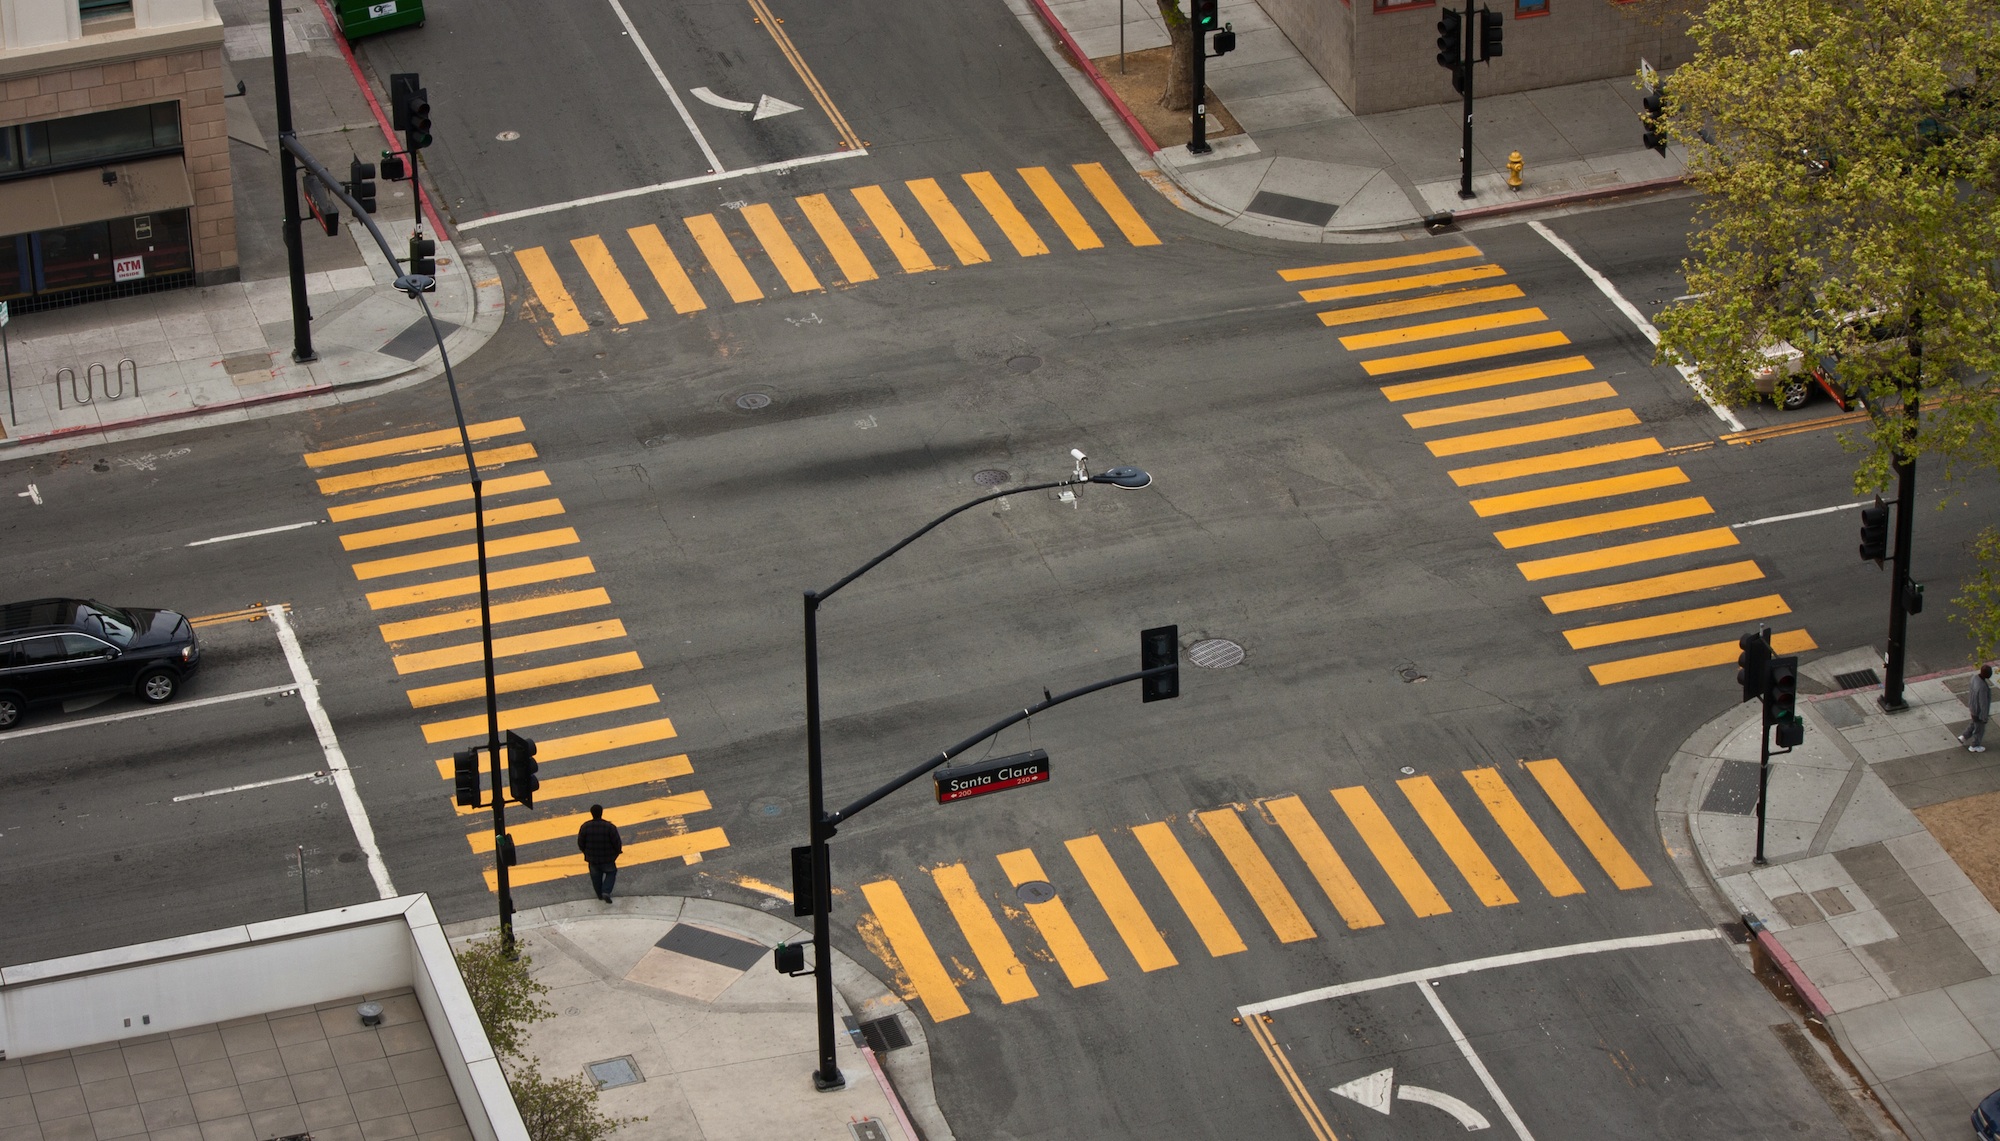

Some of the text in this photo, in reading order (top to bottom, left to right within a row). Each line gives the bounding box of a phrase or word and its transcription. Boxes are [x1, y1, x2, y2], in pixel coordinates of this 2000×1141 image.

[117, 260, 141, 273] ATM
[951, 765, 1038, 792] Santa Clara
[1017, 777, 1030, 785] 250
